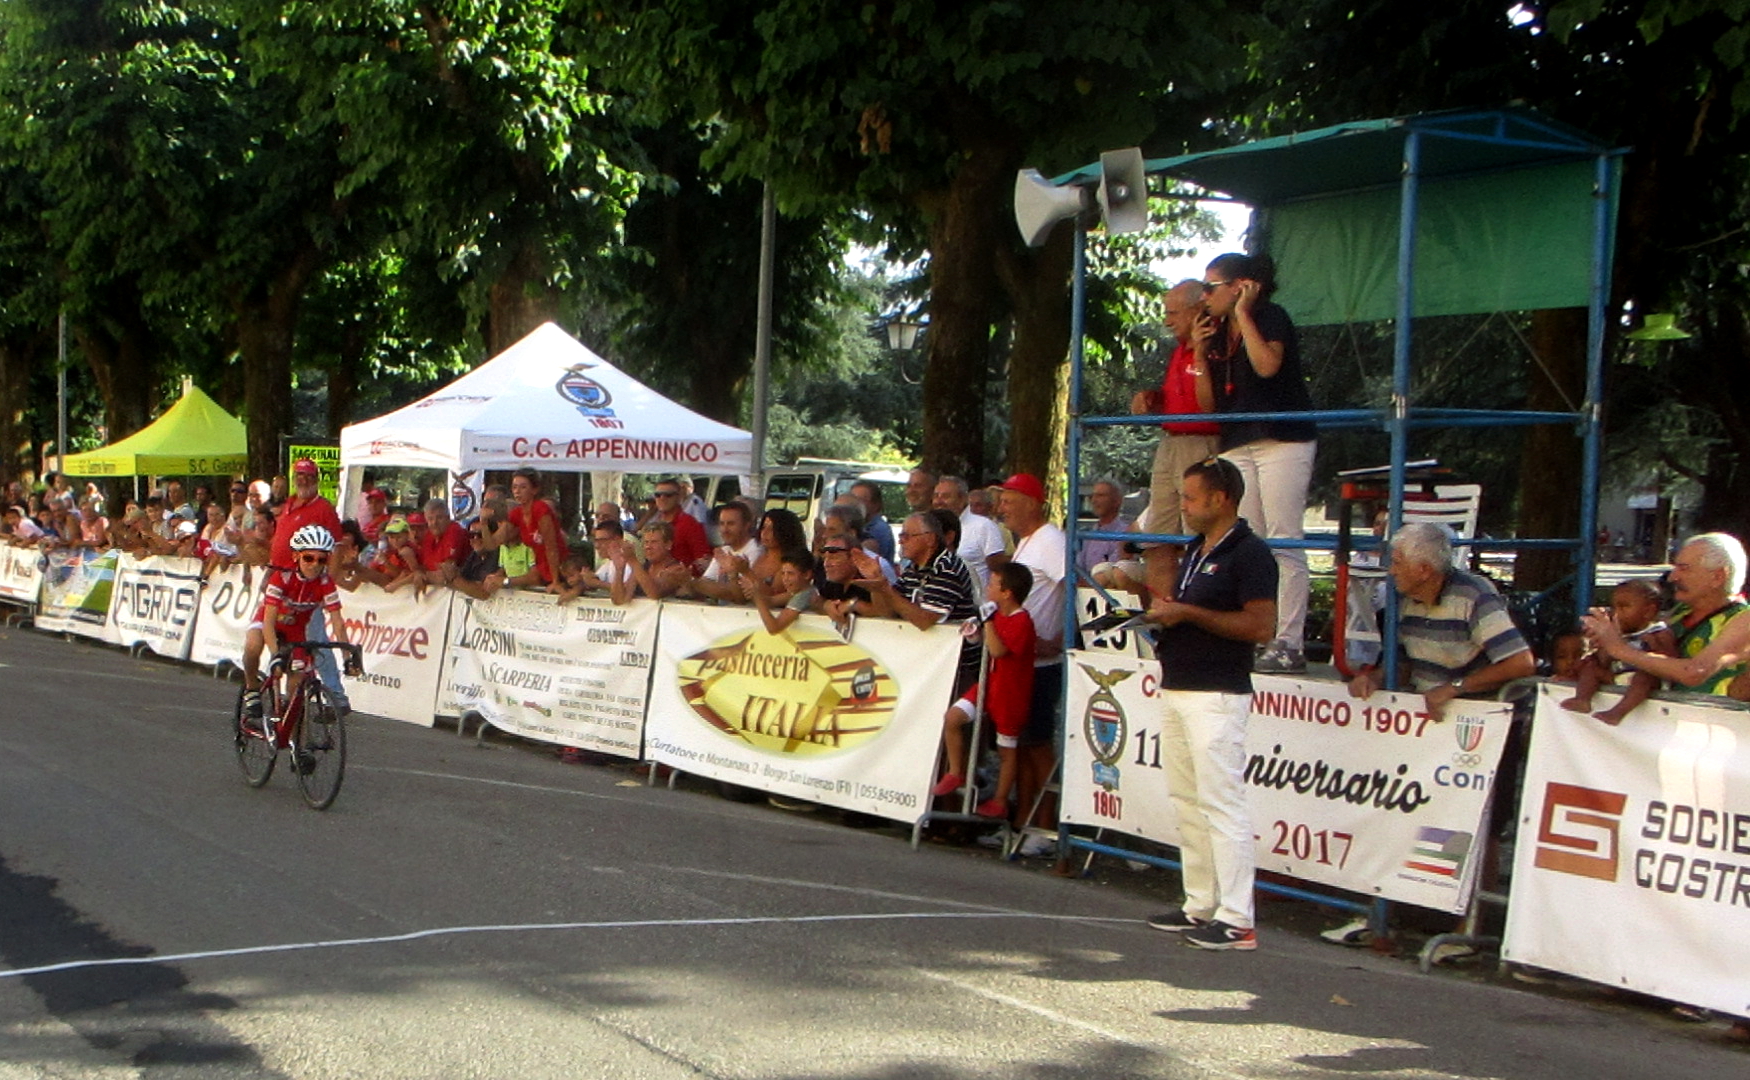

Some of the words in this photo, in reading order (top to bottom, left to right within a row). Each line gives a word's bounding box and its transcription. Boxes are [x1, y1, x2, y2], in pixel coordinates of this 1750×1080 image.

[588, 418, 625, 429] 1907
[512, 437, 558, 459] C.C.
[565, 438, 718, 462] APPENNINICO
[120, 581, 195, 626] FIGROS
[489, 661, 552, 693] SCARPERIA
[741, 694, 840, 748] ITALIA
[1361, 706, 1430, 738] 1907
[650, 737, 696, 760] Curtatone
[763, 764, 788, 782] Borgo
[790, 769, 802, 782] San
[803, 773, 835, 791] Lorenzo
[836, 780, 852, 796] (FI)
[1434, 765, 1496, 791] Coni
[1093, 790, 1123, 821] 1907
[1271, 819, 1354, 871] 2017
[1641, 800, 1750, 855] SOCIE
[1635, 848, 1750, 909] COSTR
